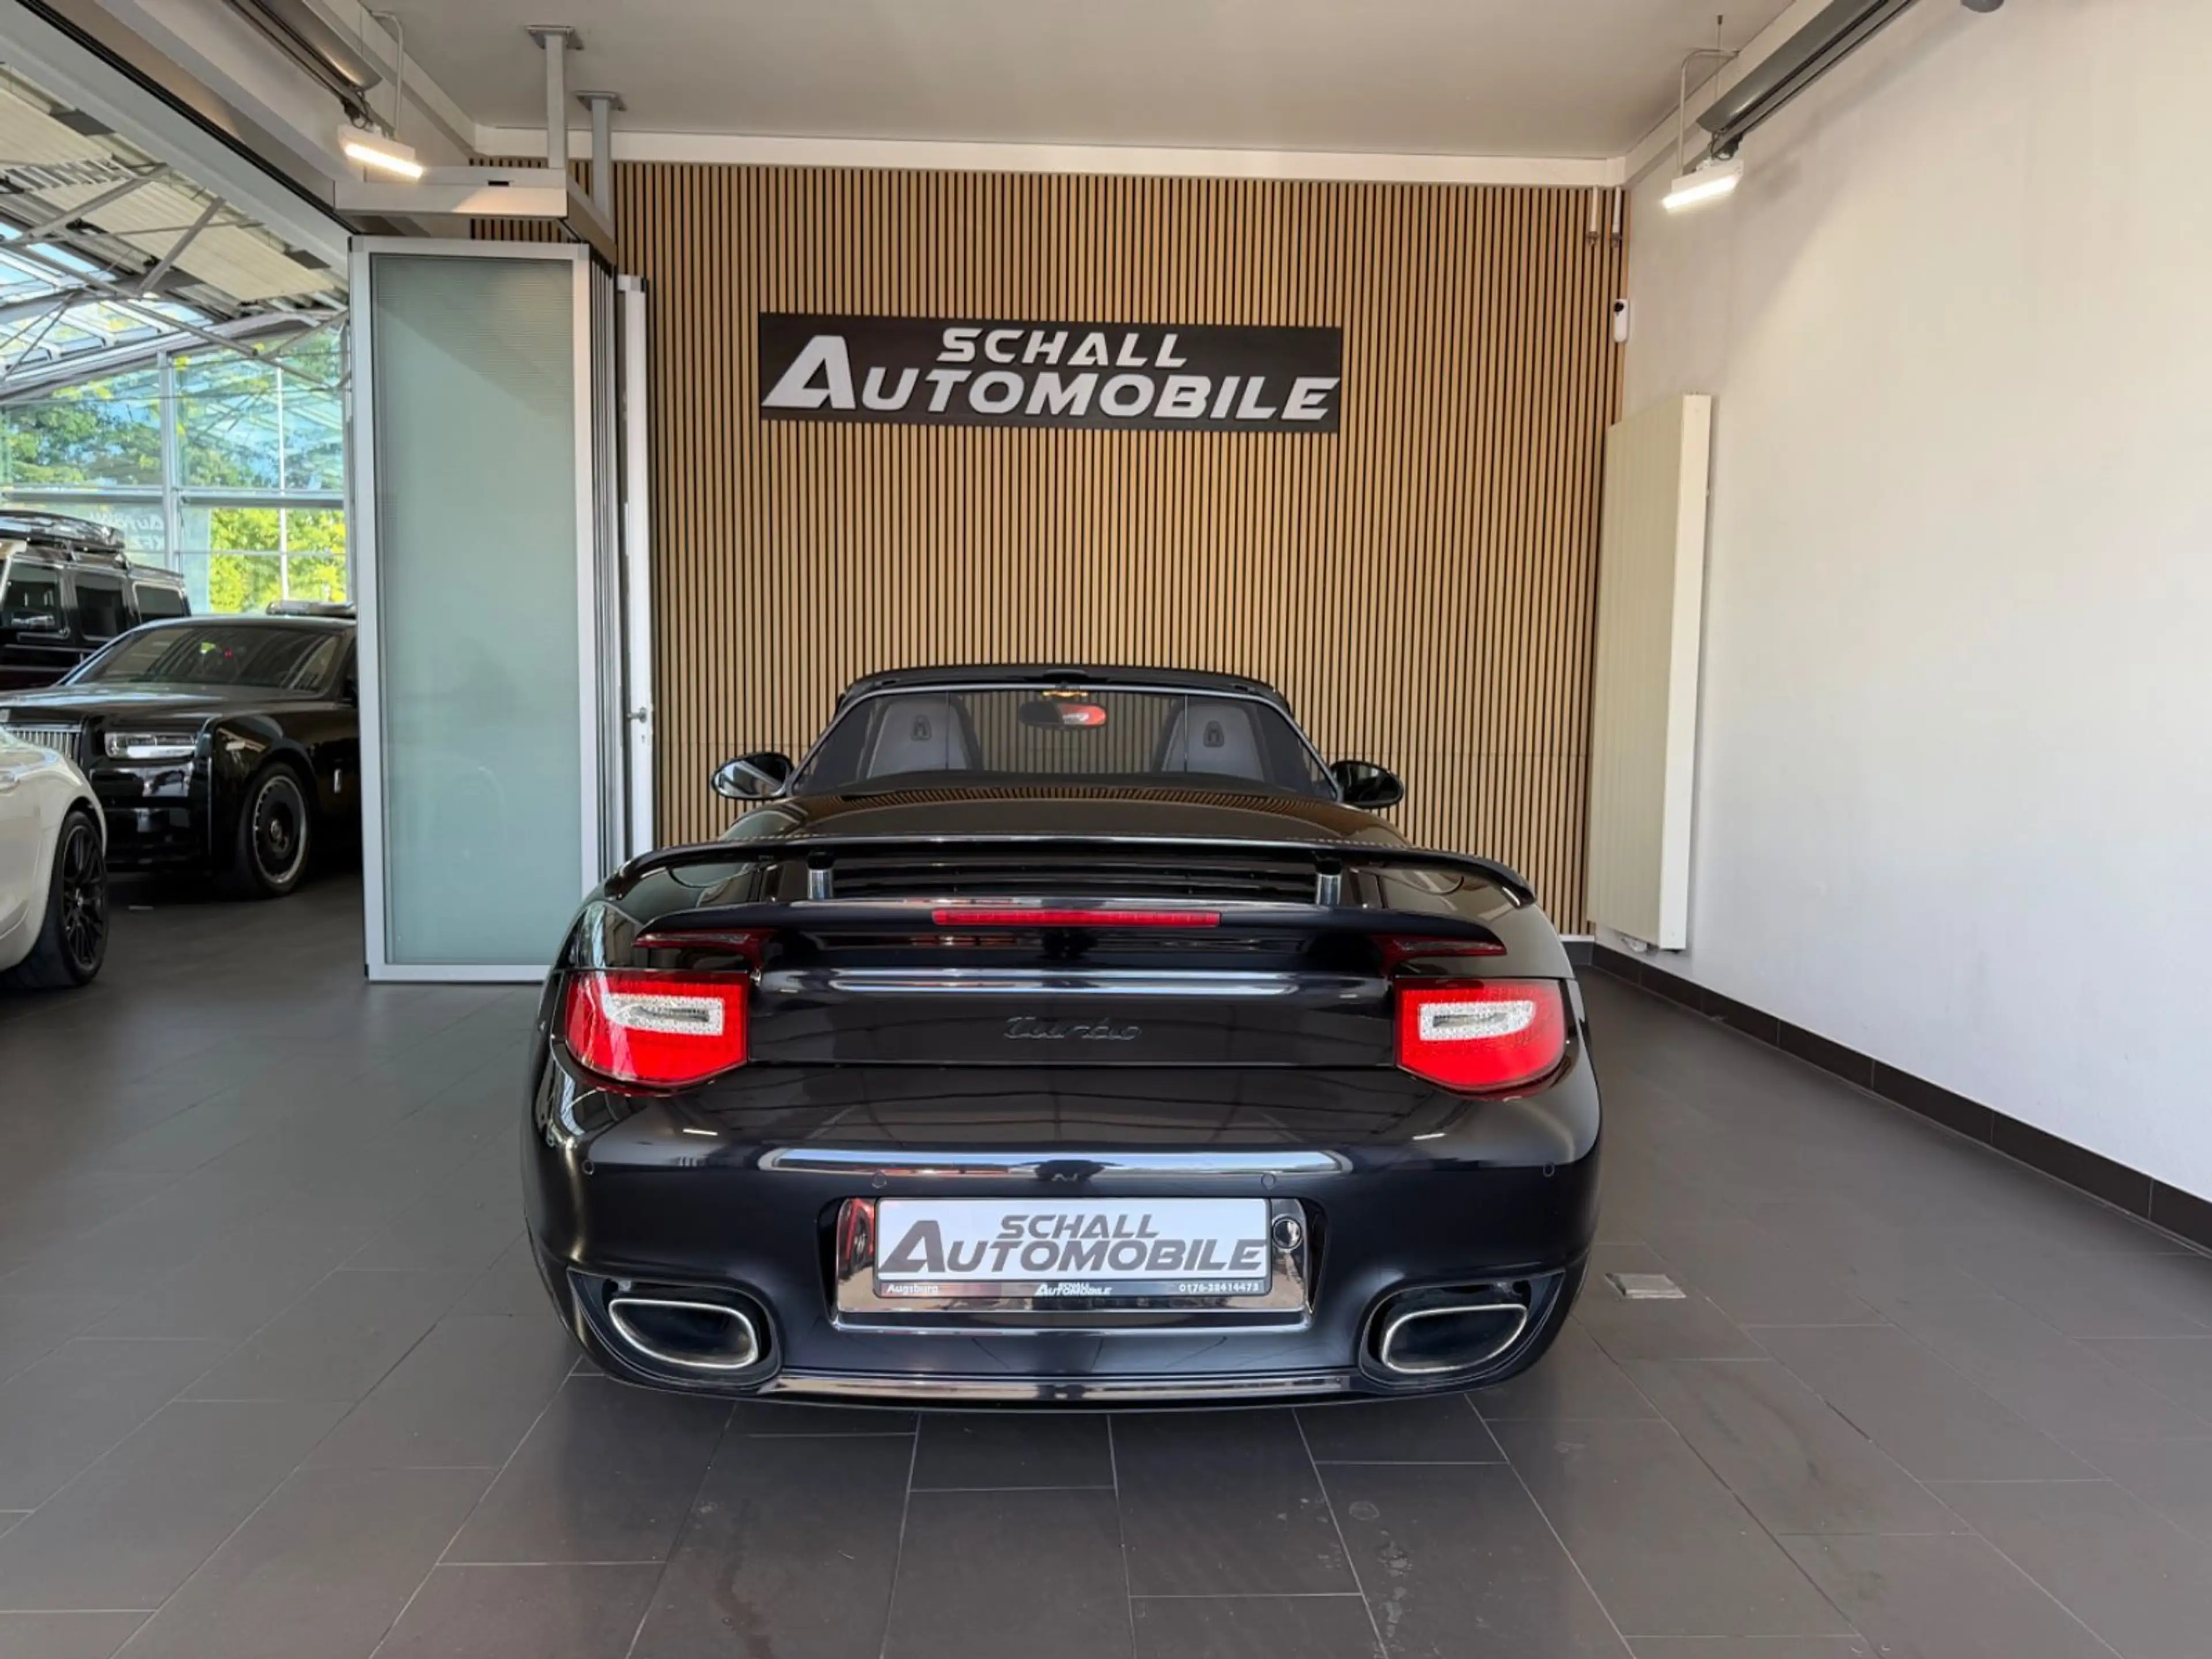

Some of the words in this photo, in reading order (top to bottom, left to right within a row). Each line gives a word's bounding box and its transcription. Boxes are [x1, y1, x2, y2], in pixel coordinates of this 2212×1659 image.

[936, 327, 1187, 368] SCHALL
[761, 335, 1340, 420] AUTOMOBILE
[879, 1219, 1267, 1273] AUTOMOBILE
[997, 1214, 1159, 1239] SCHALL
